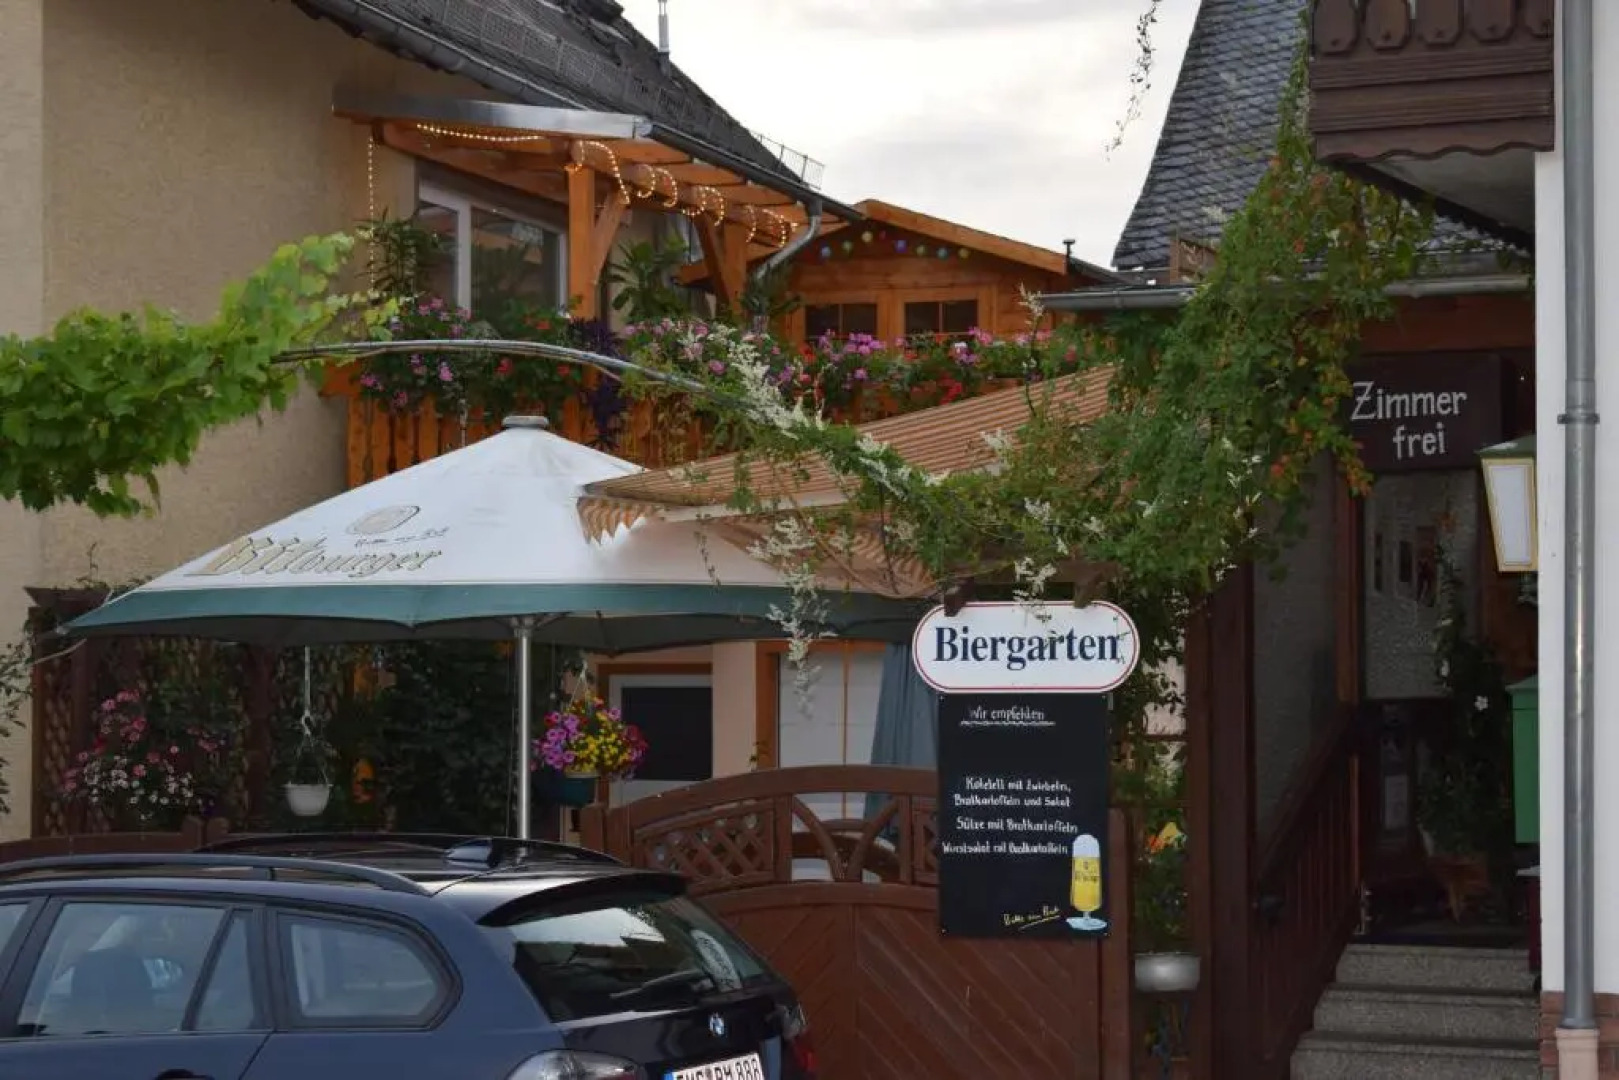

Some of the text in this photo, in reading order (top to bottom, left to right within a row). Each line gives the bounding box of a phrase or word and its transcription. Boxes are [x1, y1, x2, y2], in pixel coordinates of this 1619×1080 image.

[1351, 381, 1467, 420] Zimmer
[1393, 422, 1446, 460] frei
[932, 625, 1121, 671] Biergarten
[1007, 780, 1024, 790] mit
[1023, 796, 1042, 806] und
[1044, 796, 1070, 808] Salat
[987, 817, 1004, 831] mit
